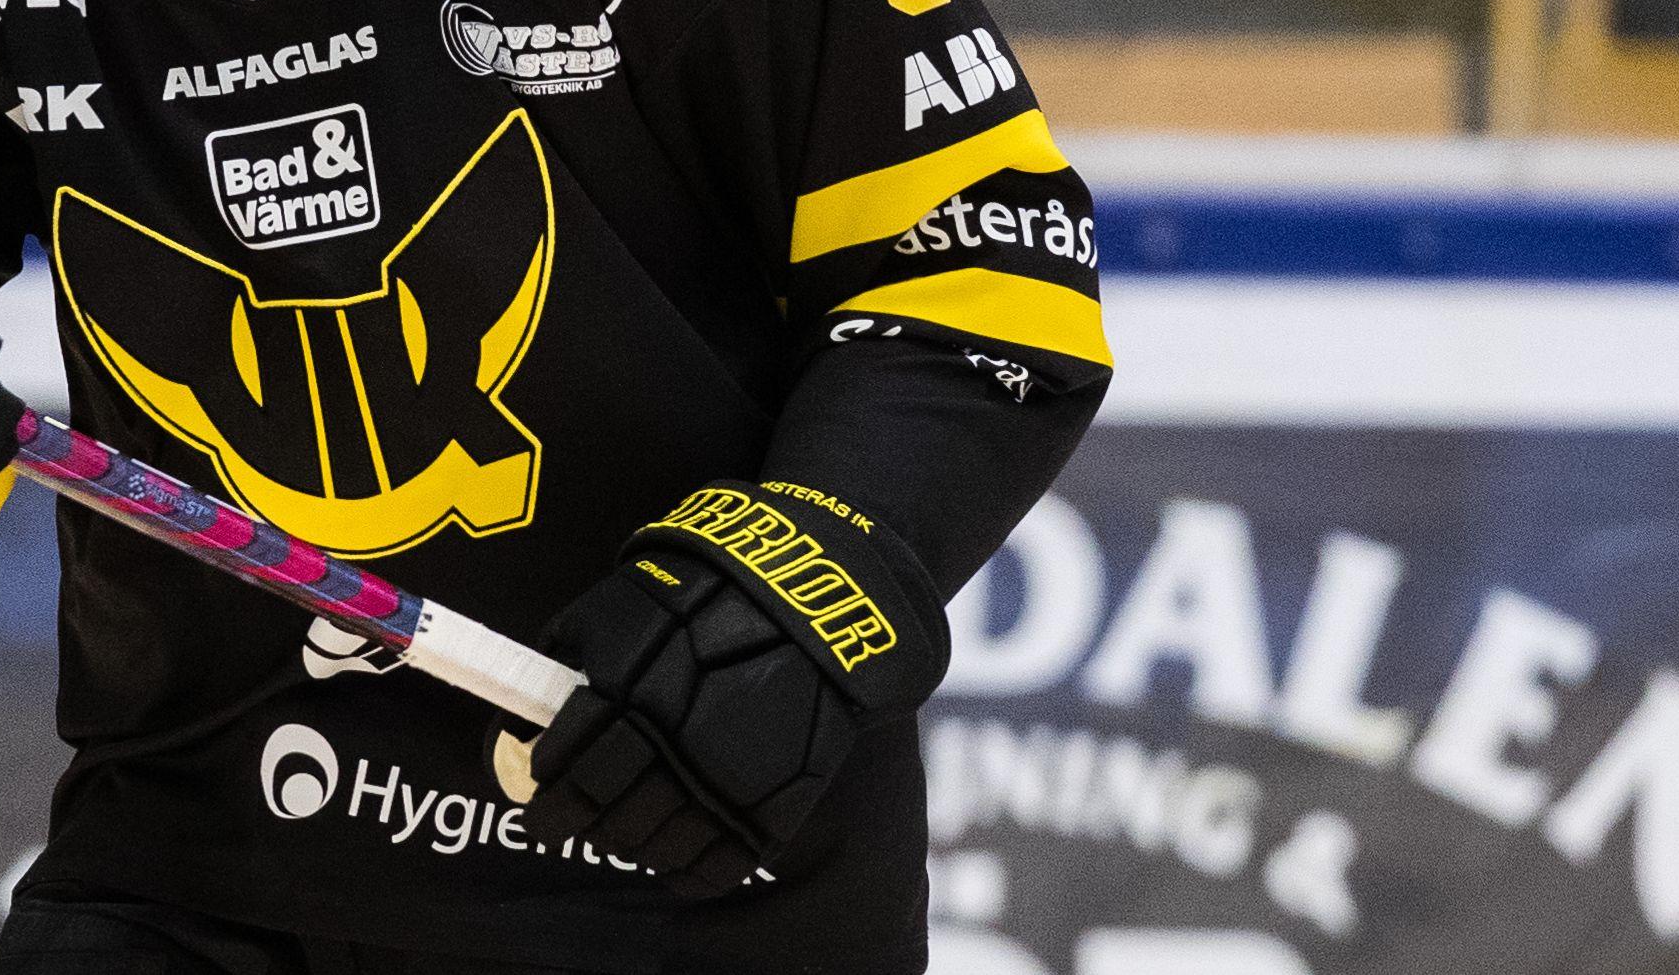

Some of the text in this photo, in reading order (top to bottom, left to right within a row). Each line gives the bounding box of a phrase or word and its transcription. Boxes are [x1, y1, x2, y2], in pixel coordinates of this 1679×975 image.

[162, 25, 378, 101] ALFAGLAS
[586, 79, 603, 90] AB
[904, 27, 1016, 132] ABB
[222, 118, 364, 196] Bad &
[228, 185, 369, 238] Värme
[851, 513, 874, 534] IK
